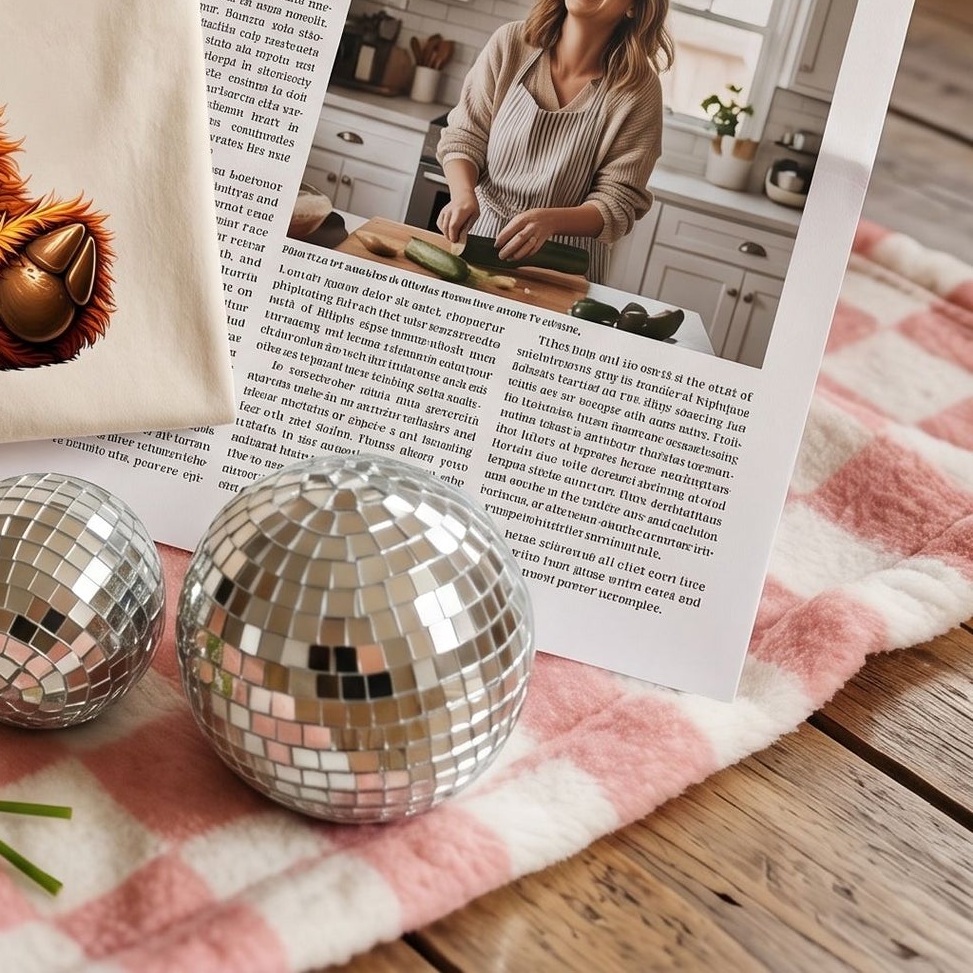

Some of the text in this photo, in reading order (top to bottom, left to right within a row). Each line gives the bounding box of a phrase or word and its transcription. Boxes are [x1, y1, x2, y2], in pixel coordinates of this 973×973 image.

[240, 59, 252, 72] in
[286, 121, 299, 133] in
[237, 252, 262, 267] and
[298, 301, 313, 316] of
[685, 376, 705, 389] the
[739, 391, 754, 402] of
[559, 489, 580, 504] the
